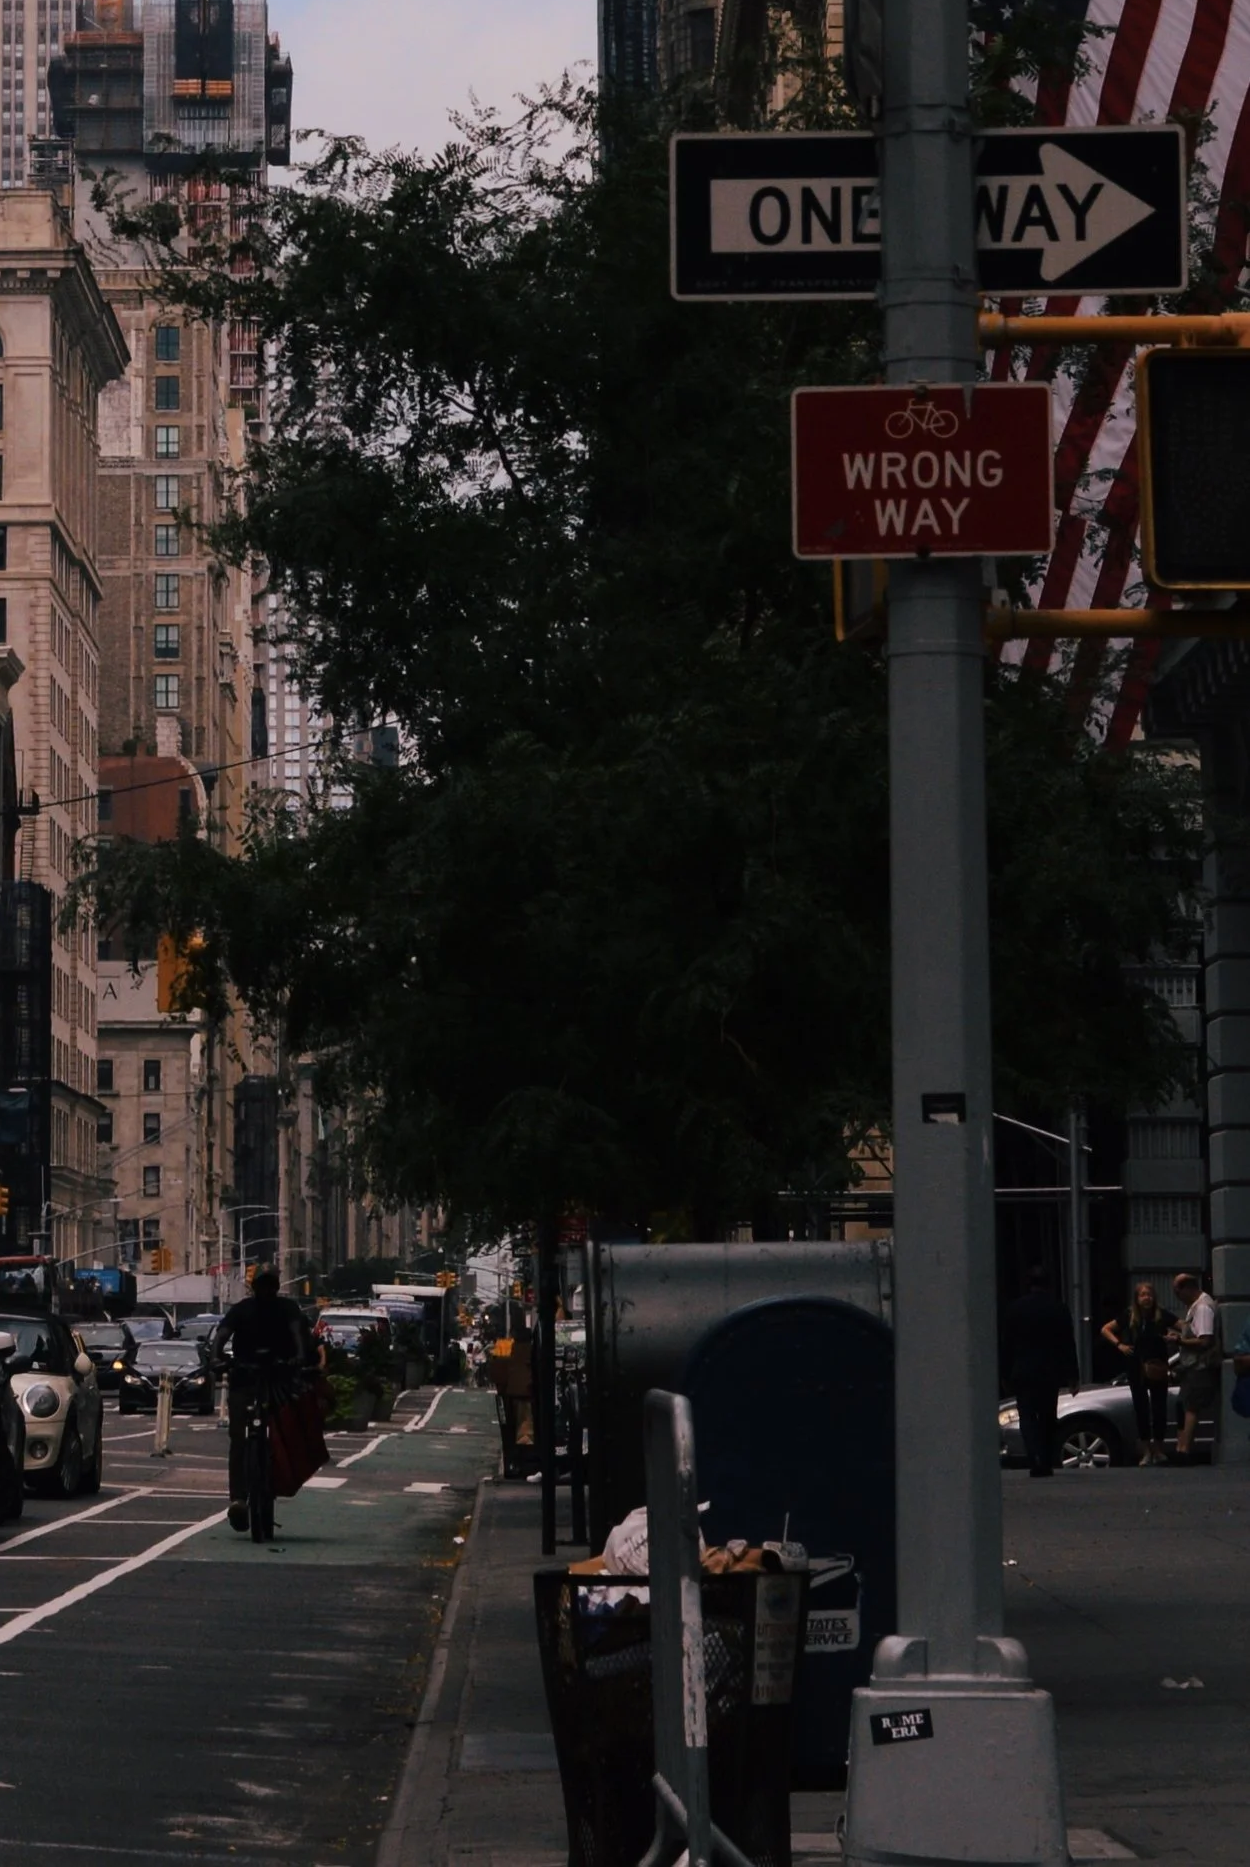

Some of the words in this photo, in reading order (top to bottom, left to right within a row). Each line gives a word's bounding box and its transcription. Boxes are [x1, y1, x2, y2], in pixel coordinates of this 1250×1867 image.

[749, 185, 881, 245] ONE
[975, 182, 1104, 243] WAY
[842, 449, 1004, 490] WRONG
[874, 496, 971, 536] WAY
[806, 1617, 848, 1630] TATES
[805, 1633, 853, 1645] ERVICE
[891, 1725, 919, 1739] ERA
